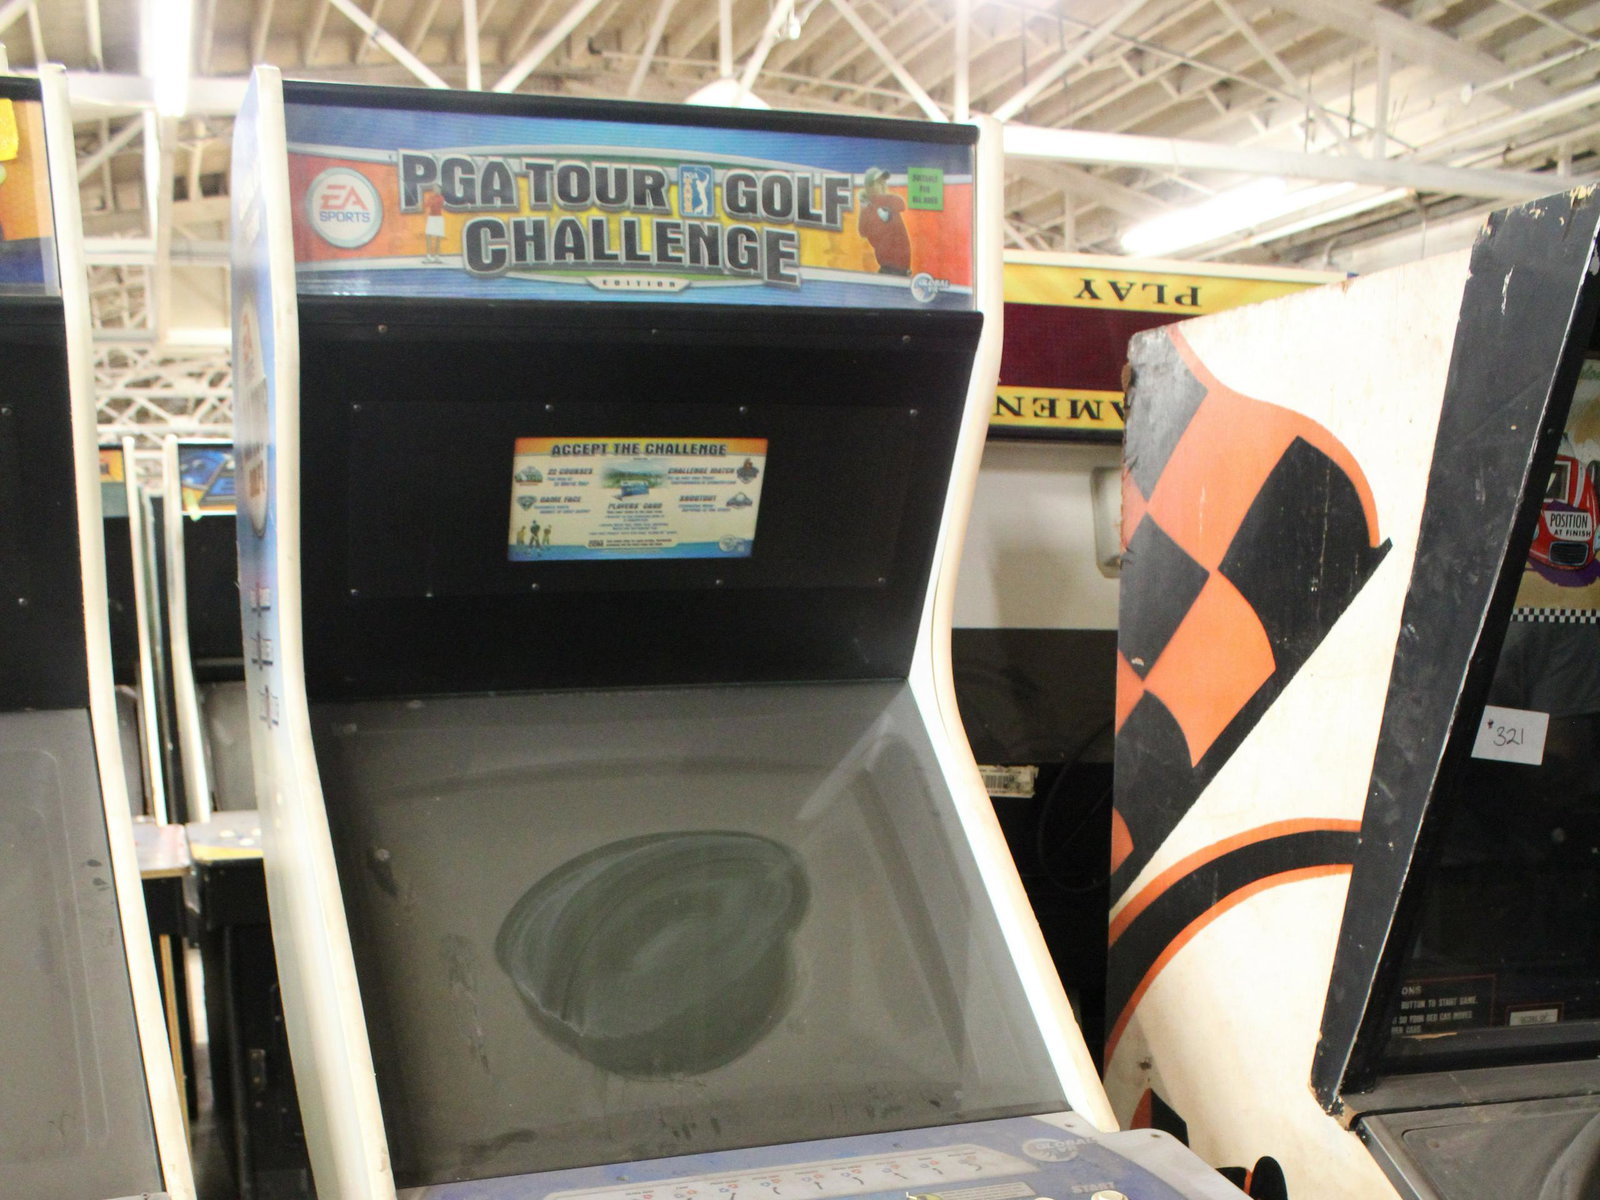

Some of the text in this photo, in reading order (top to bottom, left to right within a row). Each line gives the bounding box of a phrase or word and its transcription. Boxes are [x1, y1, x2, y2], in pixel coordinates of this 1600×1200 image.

[319, 184, 368, 211] EA
[400, 150, 518, 212] PGA
[522, 157, 671, 215] TOUR
[723, 168, 854, 231] GOLF
[318, 210, 370, 223] SPORTS
[462, 216, 801, 288] CHALLENGE
[602, 279, 676, 288] EDITION
[1073, 278, 1203, 307] PLAY
[551, 443, 727, 456] ACCEPT THE CHALLENGE
[1550, 513, 1588, 529] POSITION
[1565, 529, 1592, 537] FINISH
[1071, 1181, 1115, 1194] START
